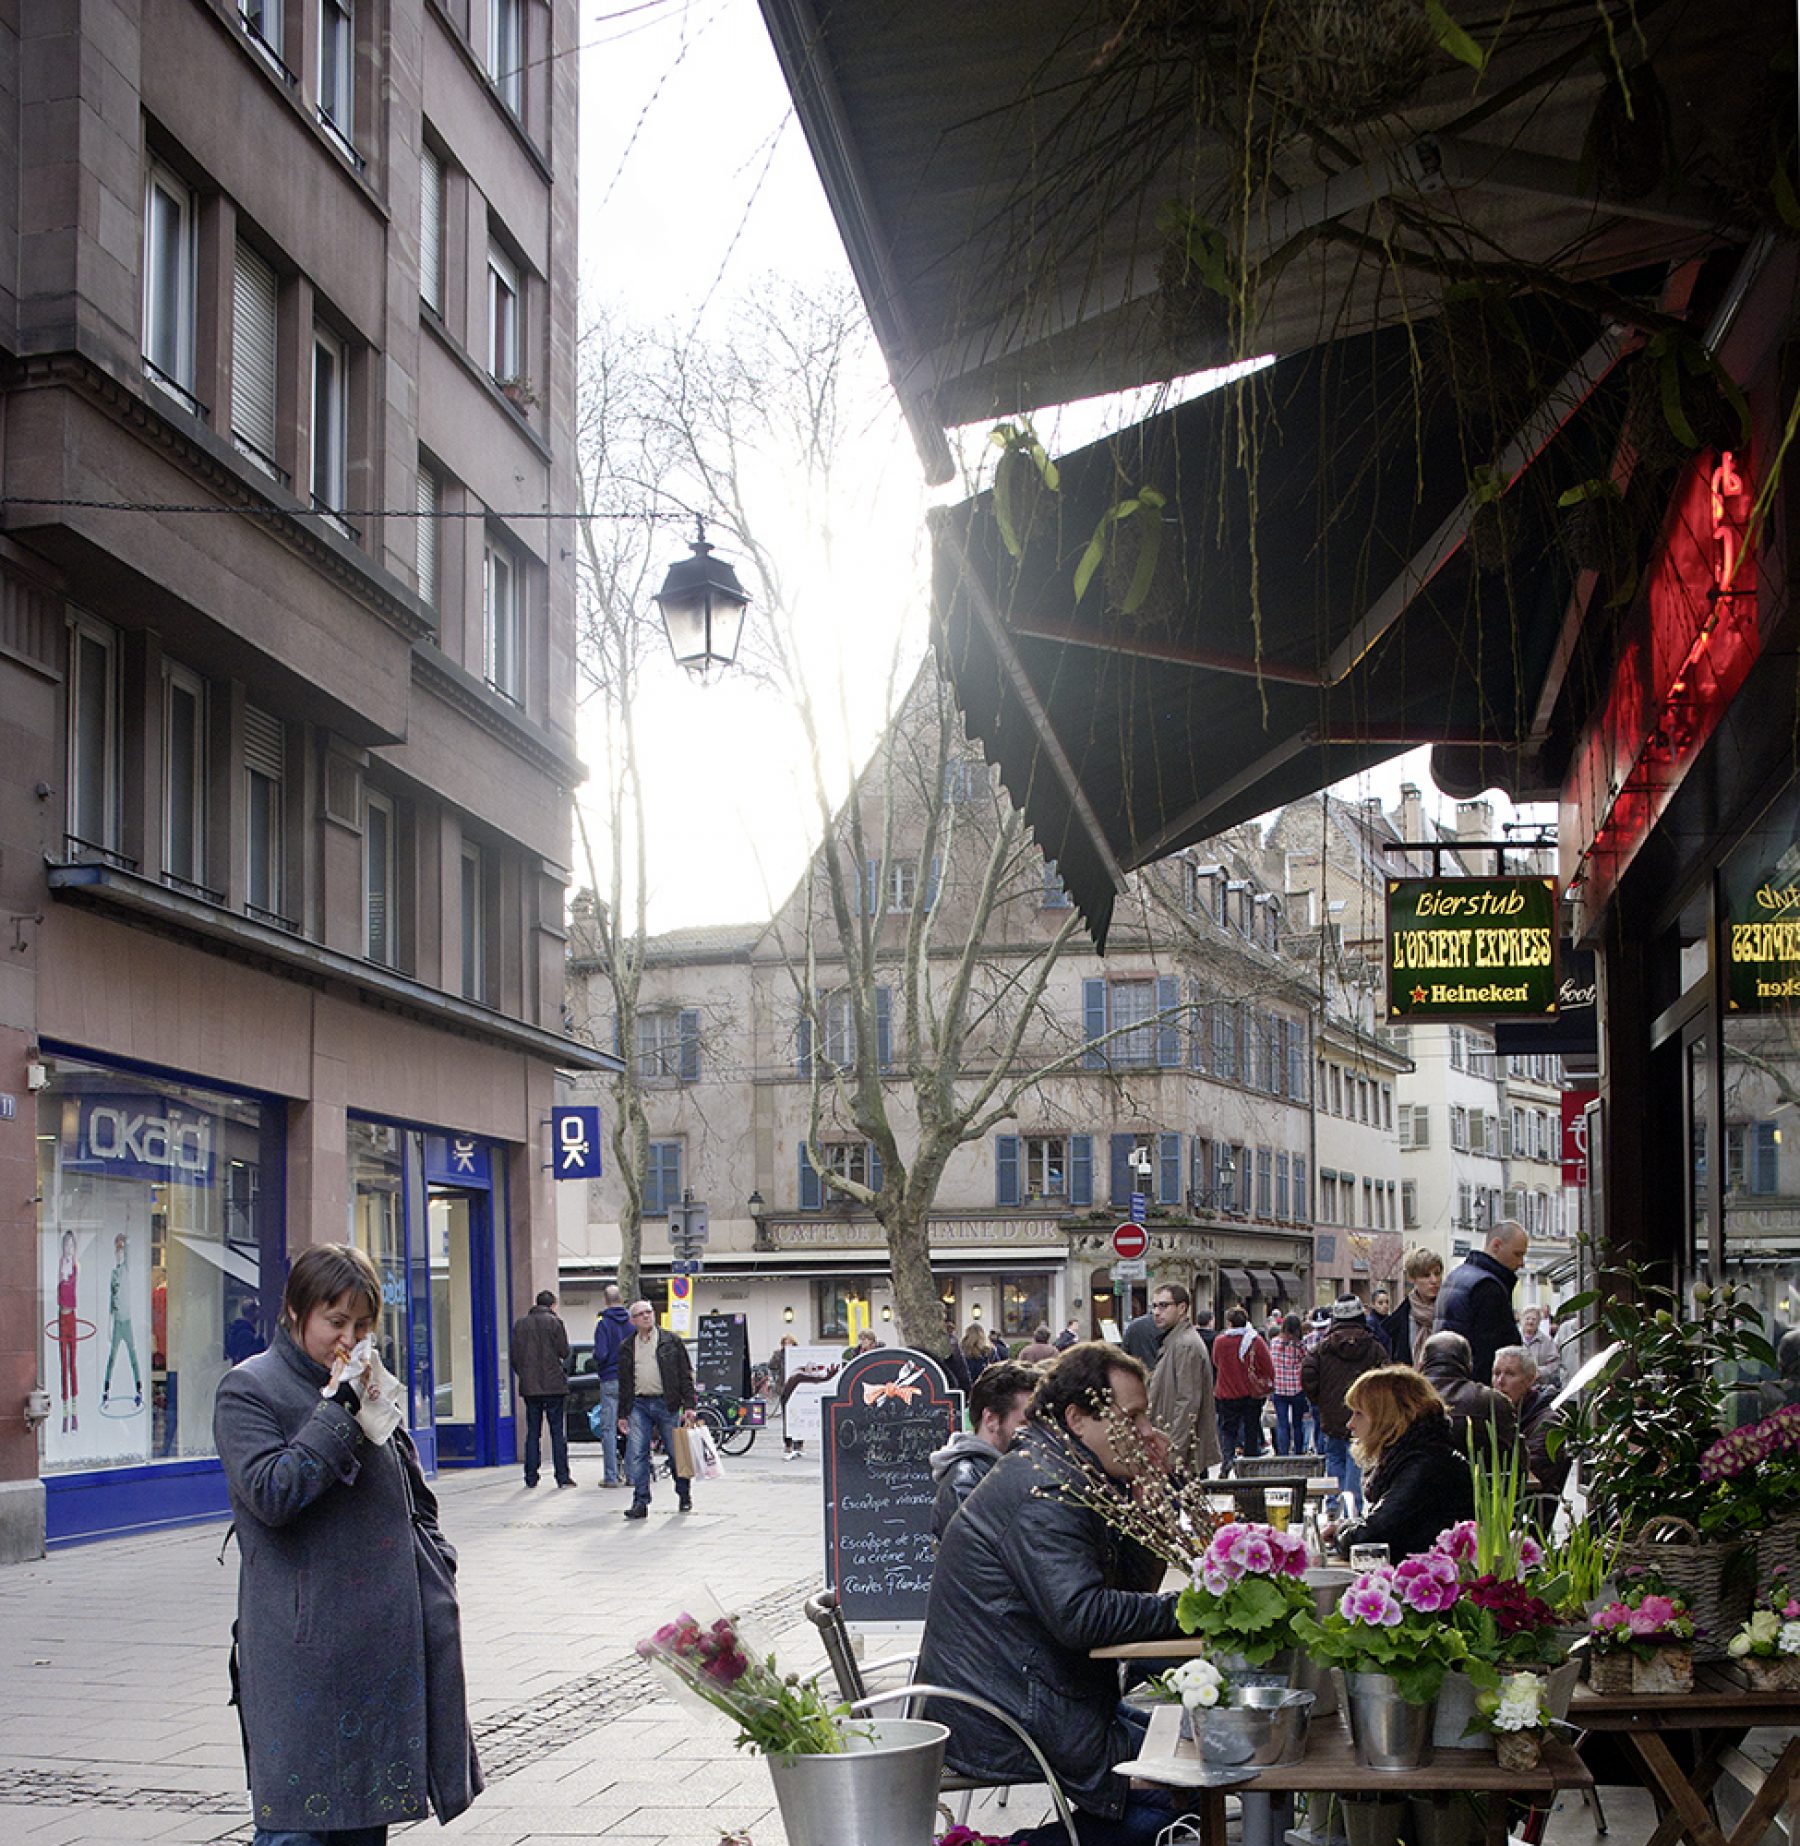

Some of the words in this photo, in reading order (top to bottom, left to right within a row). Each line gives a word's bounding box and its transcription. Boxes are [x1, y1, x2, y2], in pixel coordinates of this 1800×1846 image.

[1415, 889, 1525, 917] Bierstub
[1474, 928, 1552, 968] EXPRESS
[1430, 983, 1528, 1003] Heineken
